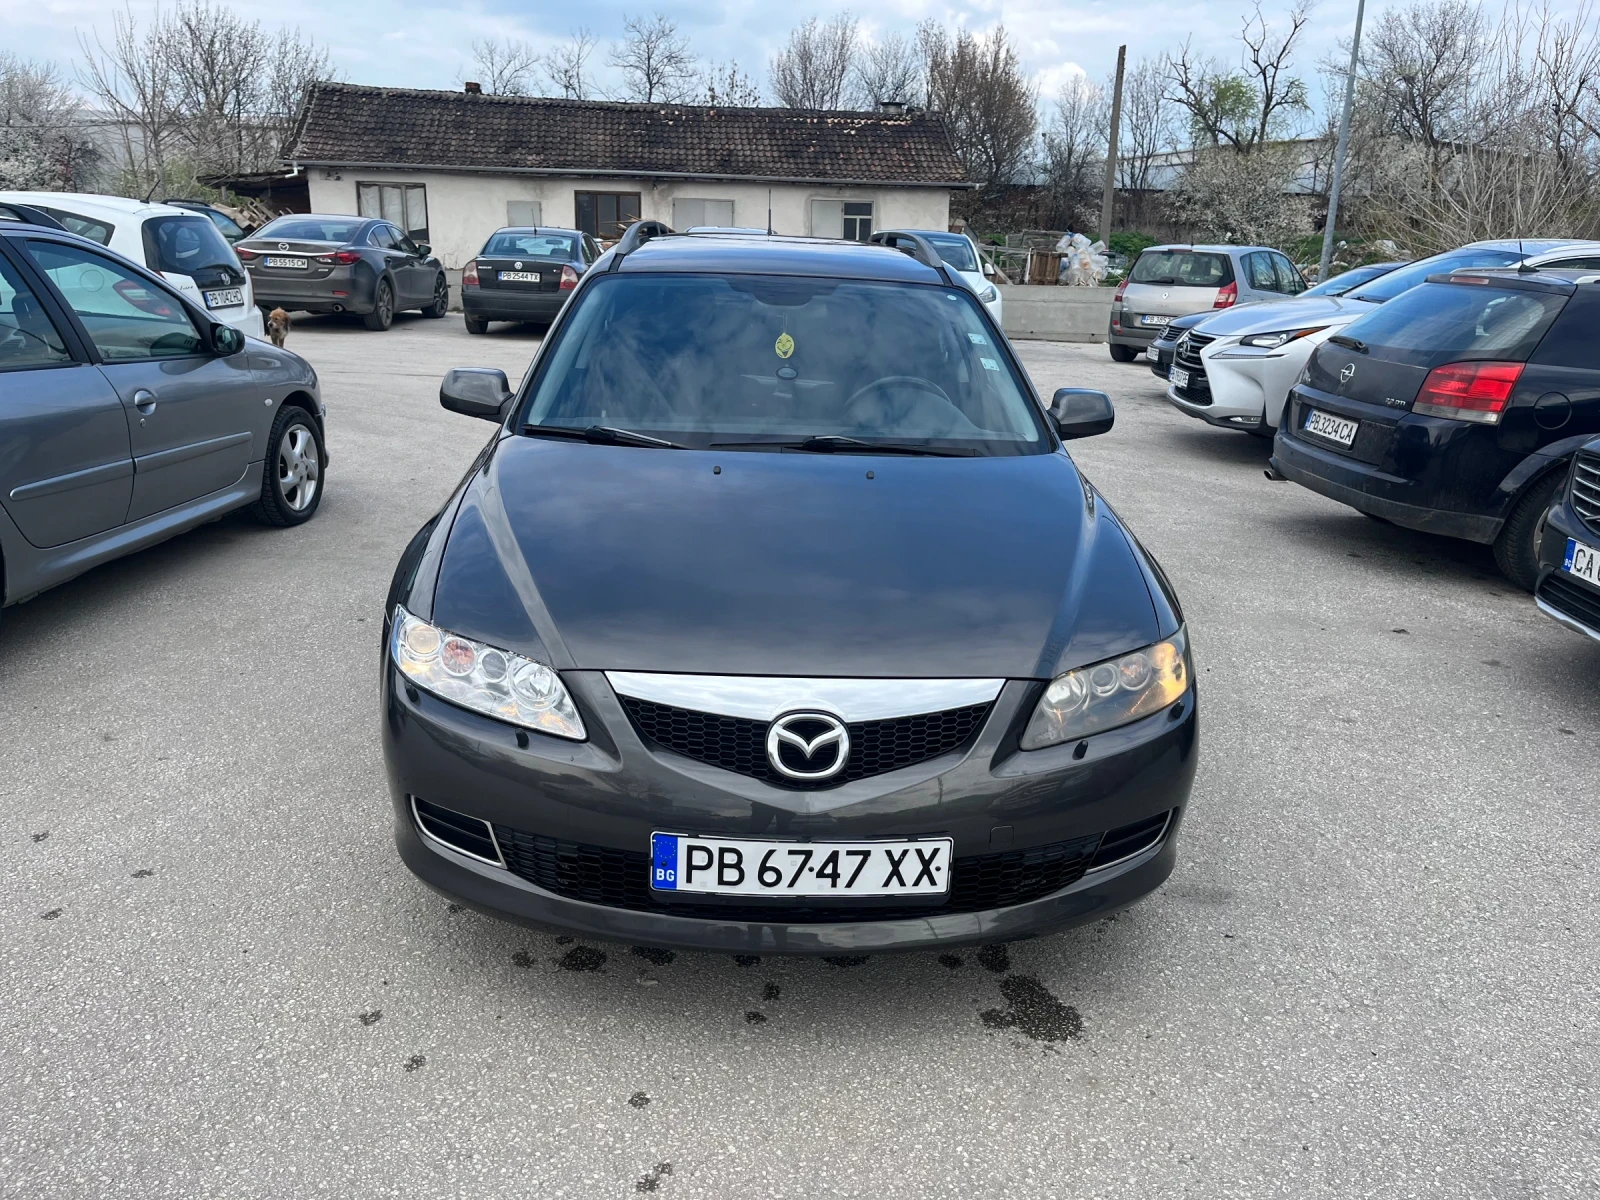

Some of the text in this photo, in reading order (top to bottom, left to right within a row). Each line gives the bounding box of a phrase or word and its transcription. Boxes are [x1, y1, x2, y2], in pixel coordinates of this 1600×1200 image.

[278, 258, 295, 266] 5515
[209, 292, 218, 304] PB
[1308, 413, 1354, 442] PB 3234 CA
[1574, 548, 1594, 578] CA
[656, 868, 675, 882] BG
[686, 844, 942, 889] PB 6747 XX
